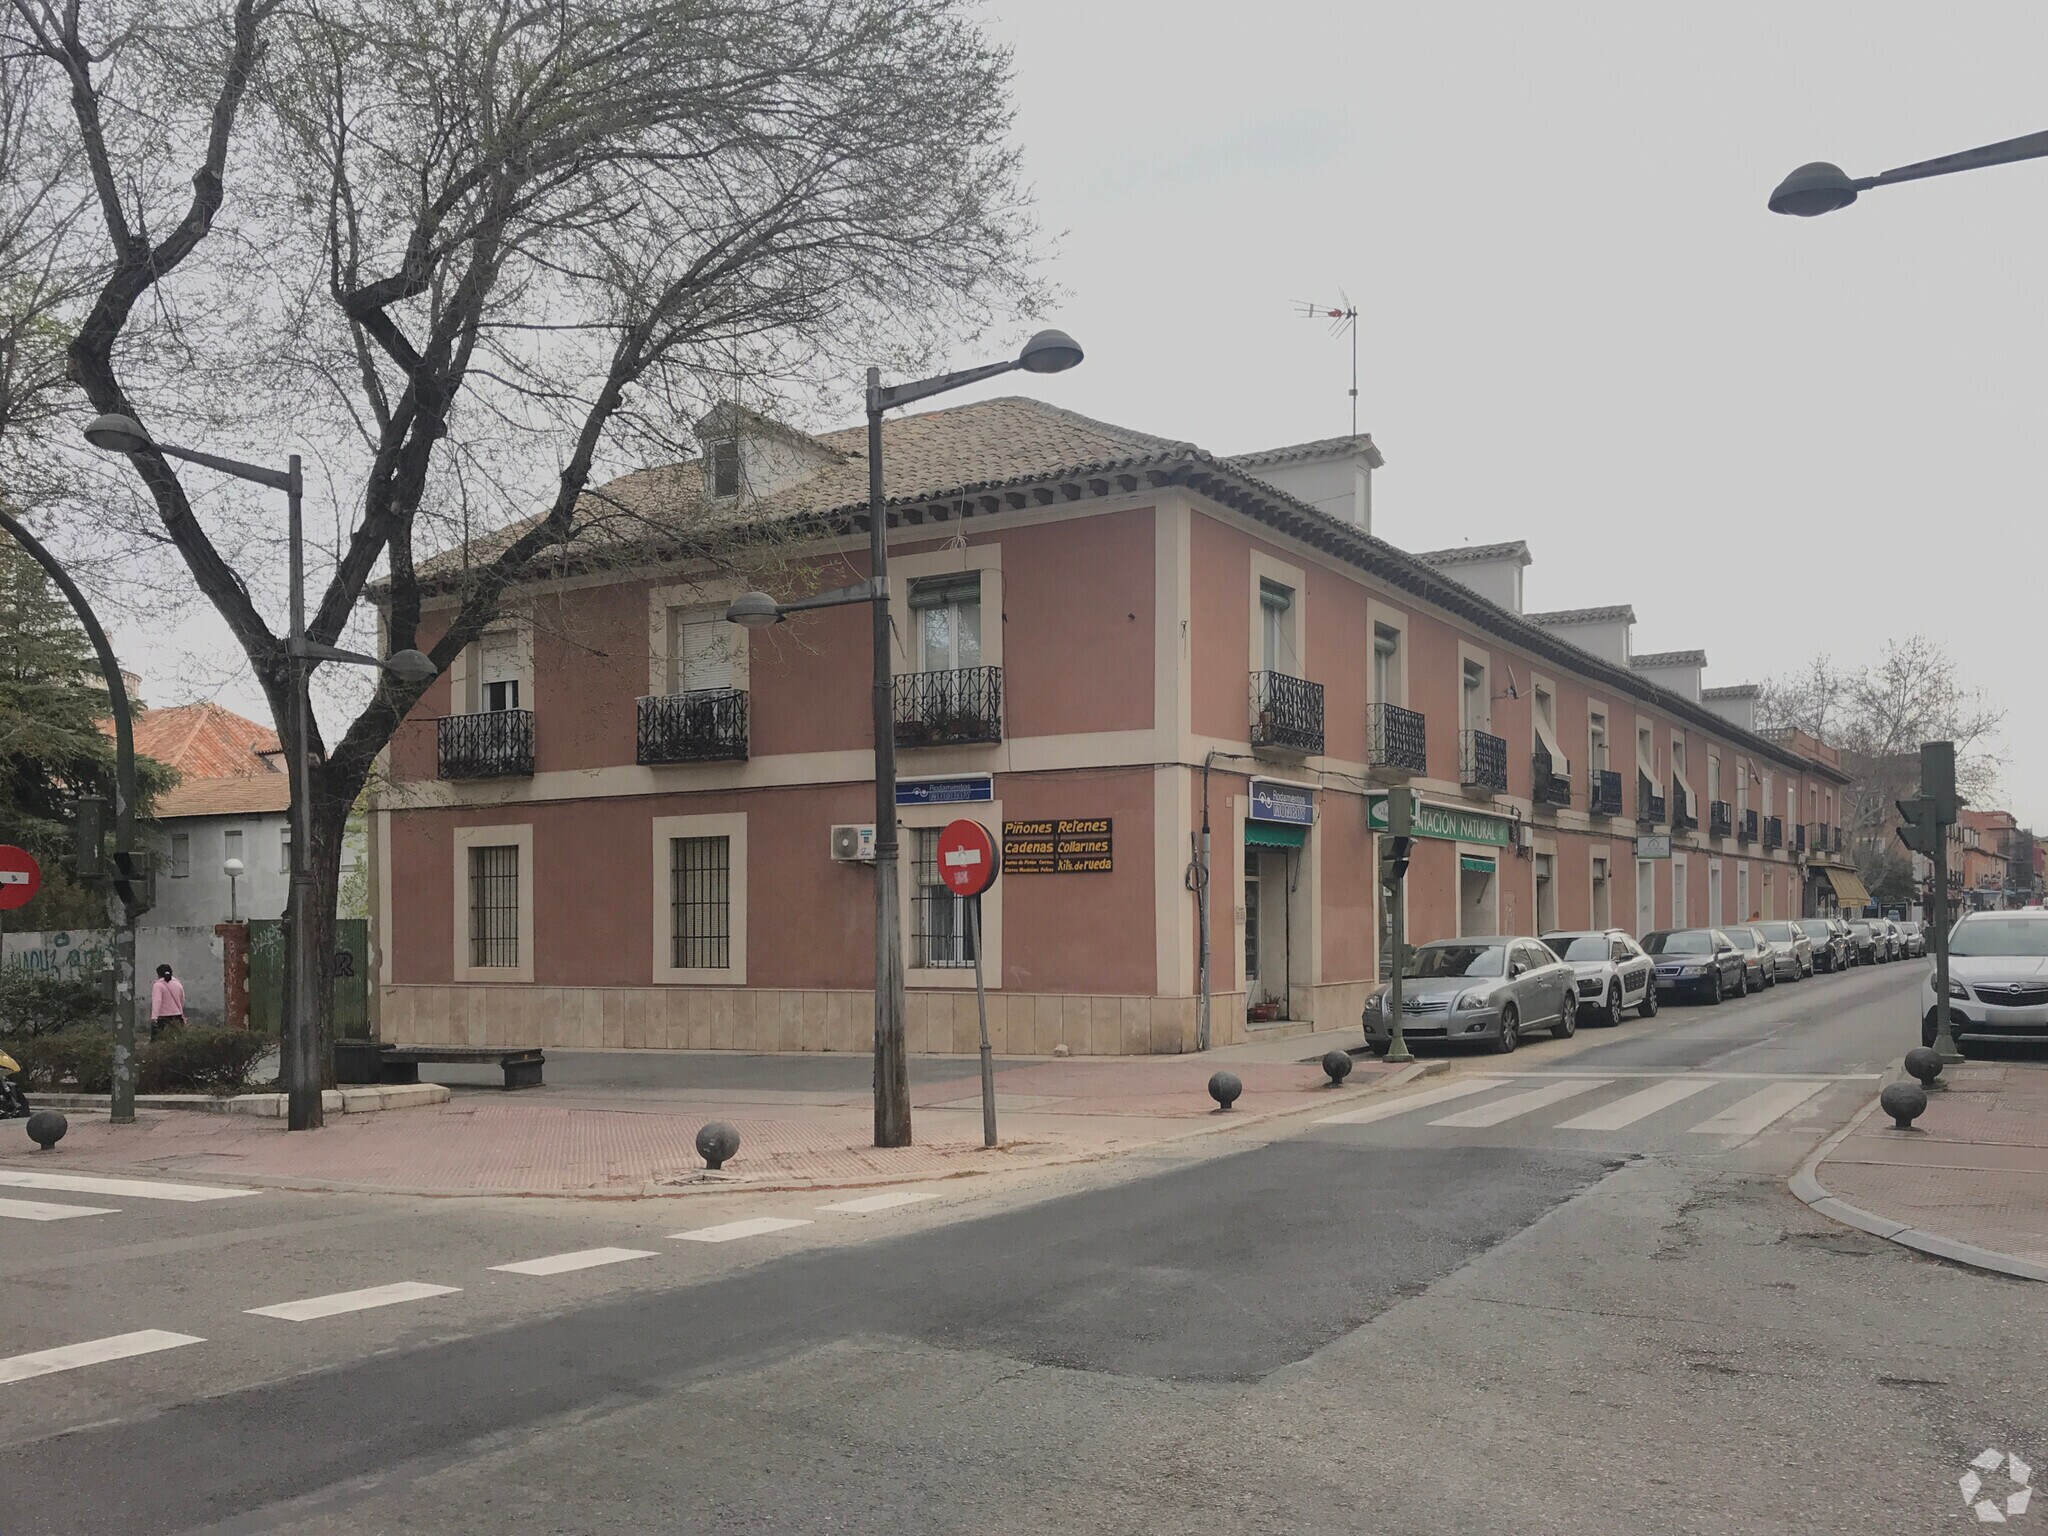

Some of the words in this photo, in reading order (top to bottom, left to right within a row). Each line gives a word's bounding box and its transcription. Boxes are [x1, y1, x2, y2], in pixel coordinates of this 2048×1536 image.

[929, 783, 971, 792] Rodamientos
[1272, 789, 1306, 804] Rodamientos
[1272, 803, 1307, 820] MONROY
[1004, 821, 1052, 834] Piñones
[1057, 819, 1108, 833] Retenes
[1418, 809, 1457, 835] NTACIÓN
[1460, 817, 1496, 840] NATURAL
[1004, 842, 1054, 853] Cadenas
[1057, 840, 1108, 853] Collarines
[1084, 858, 1112, 870] rueda
